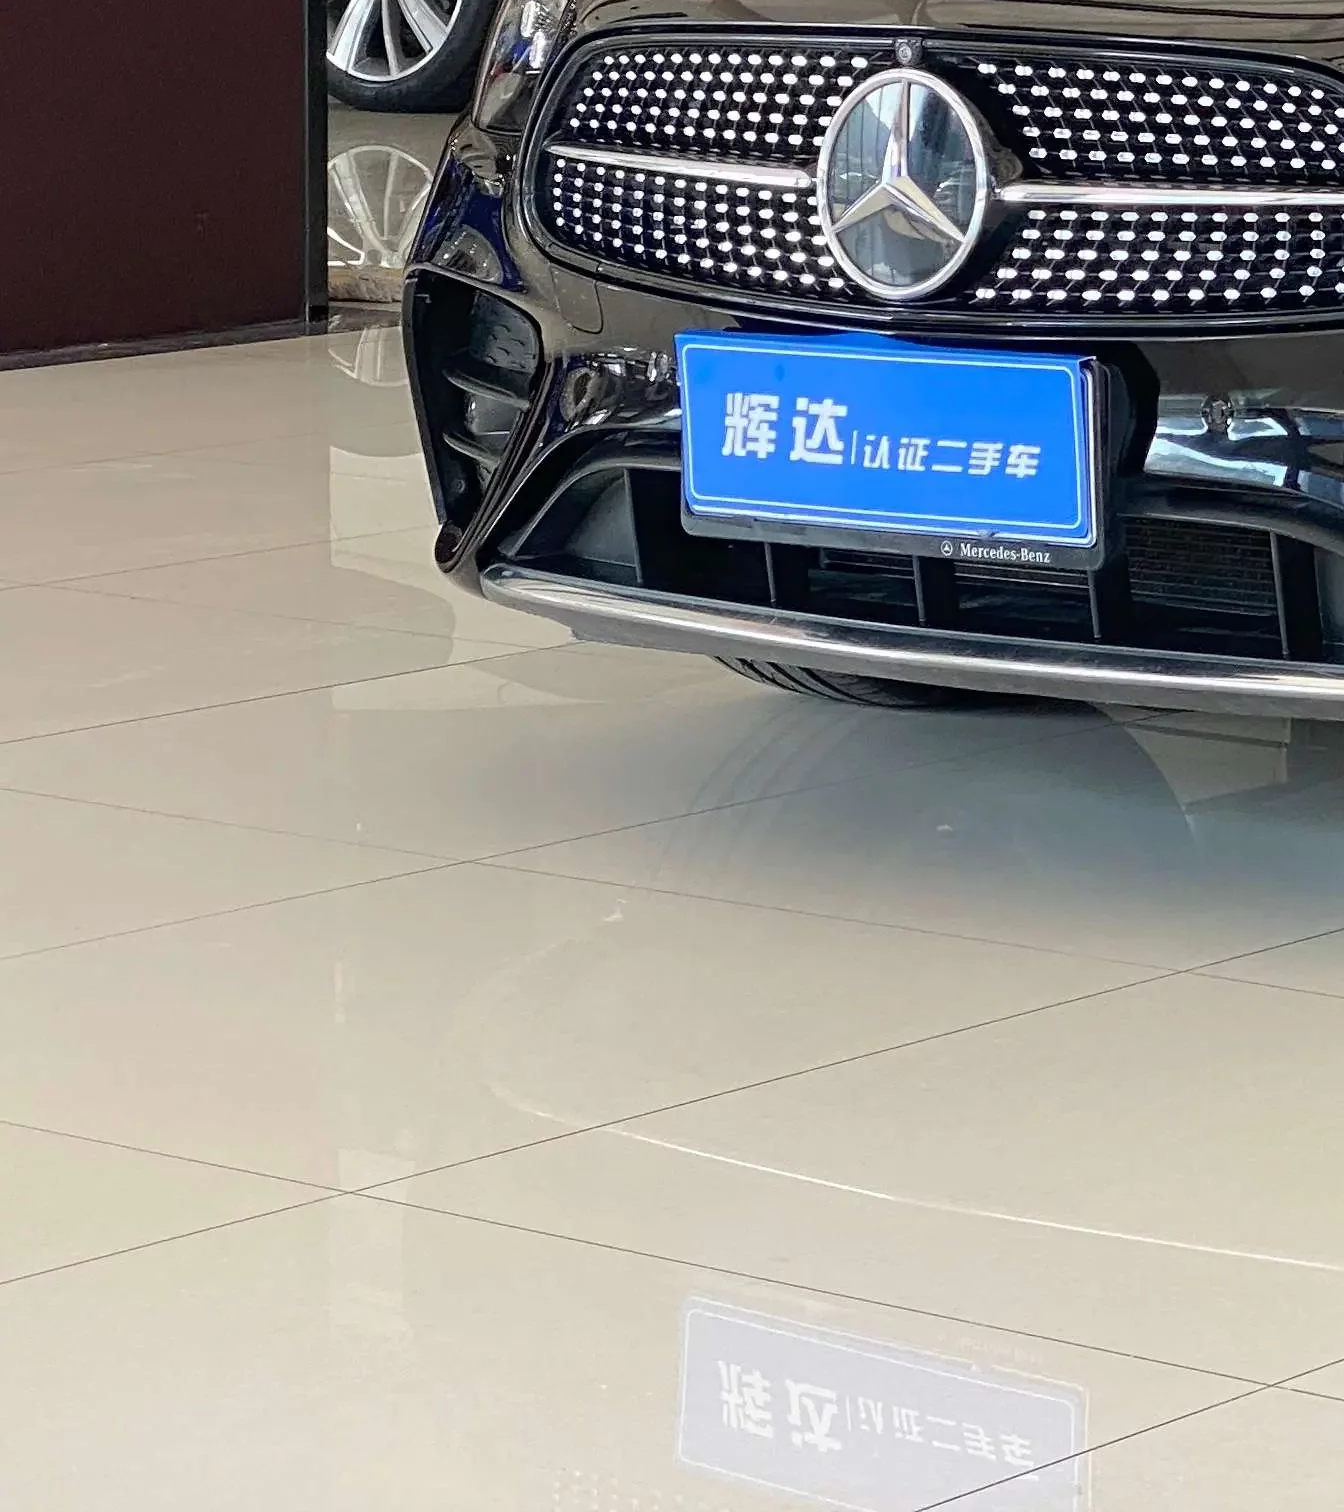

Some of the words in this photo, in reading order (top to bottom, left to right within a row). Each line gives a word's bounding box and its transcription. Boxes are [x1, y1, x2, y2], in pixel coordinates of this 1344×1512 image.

[721, 391, 848, 465] 辉达
[862, 433, 1041, 479] 认证二手车
[960, 542, 1052, 564] Mercedes-Benz
